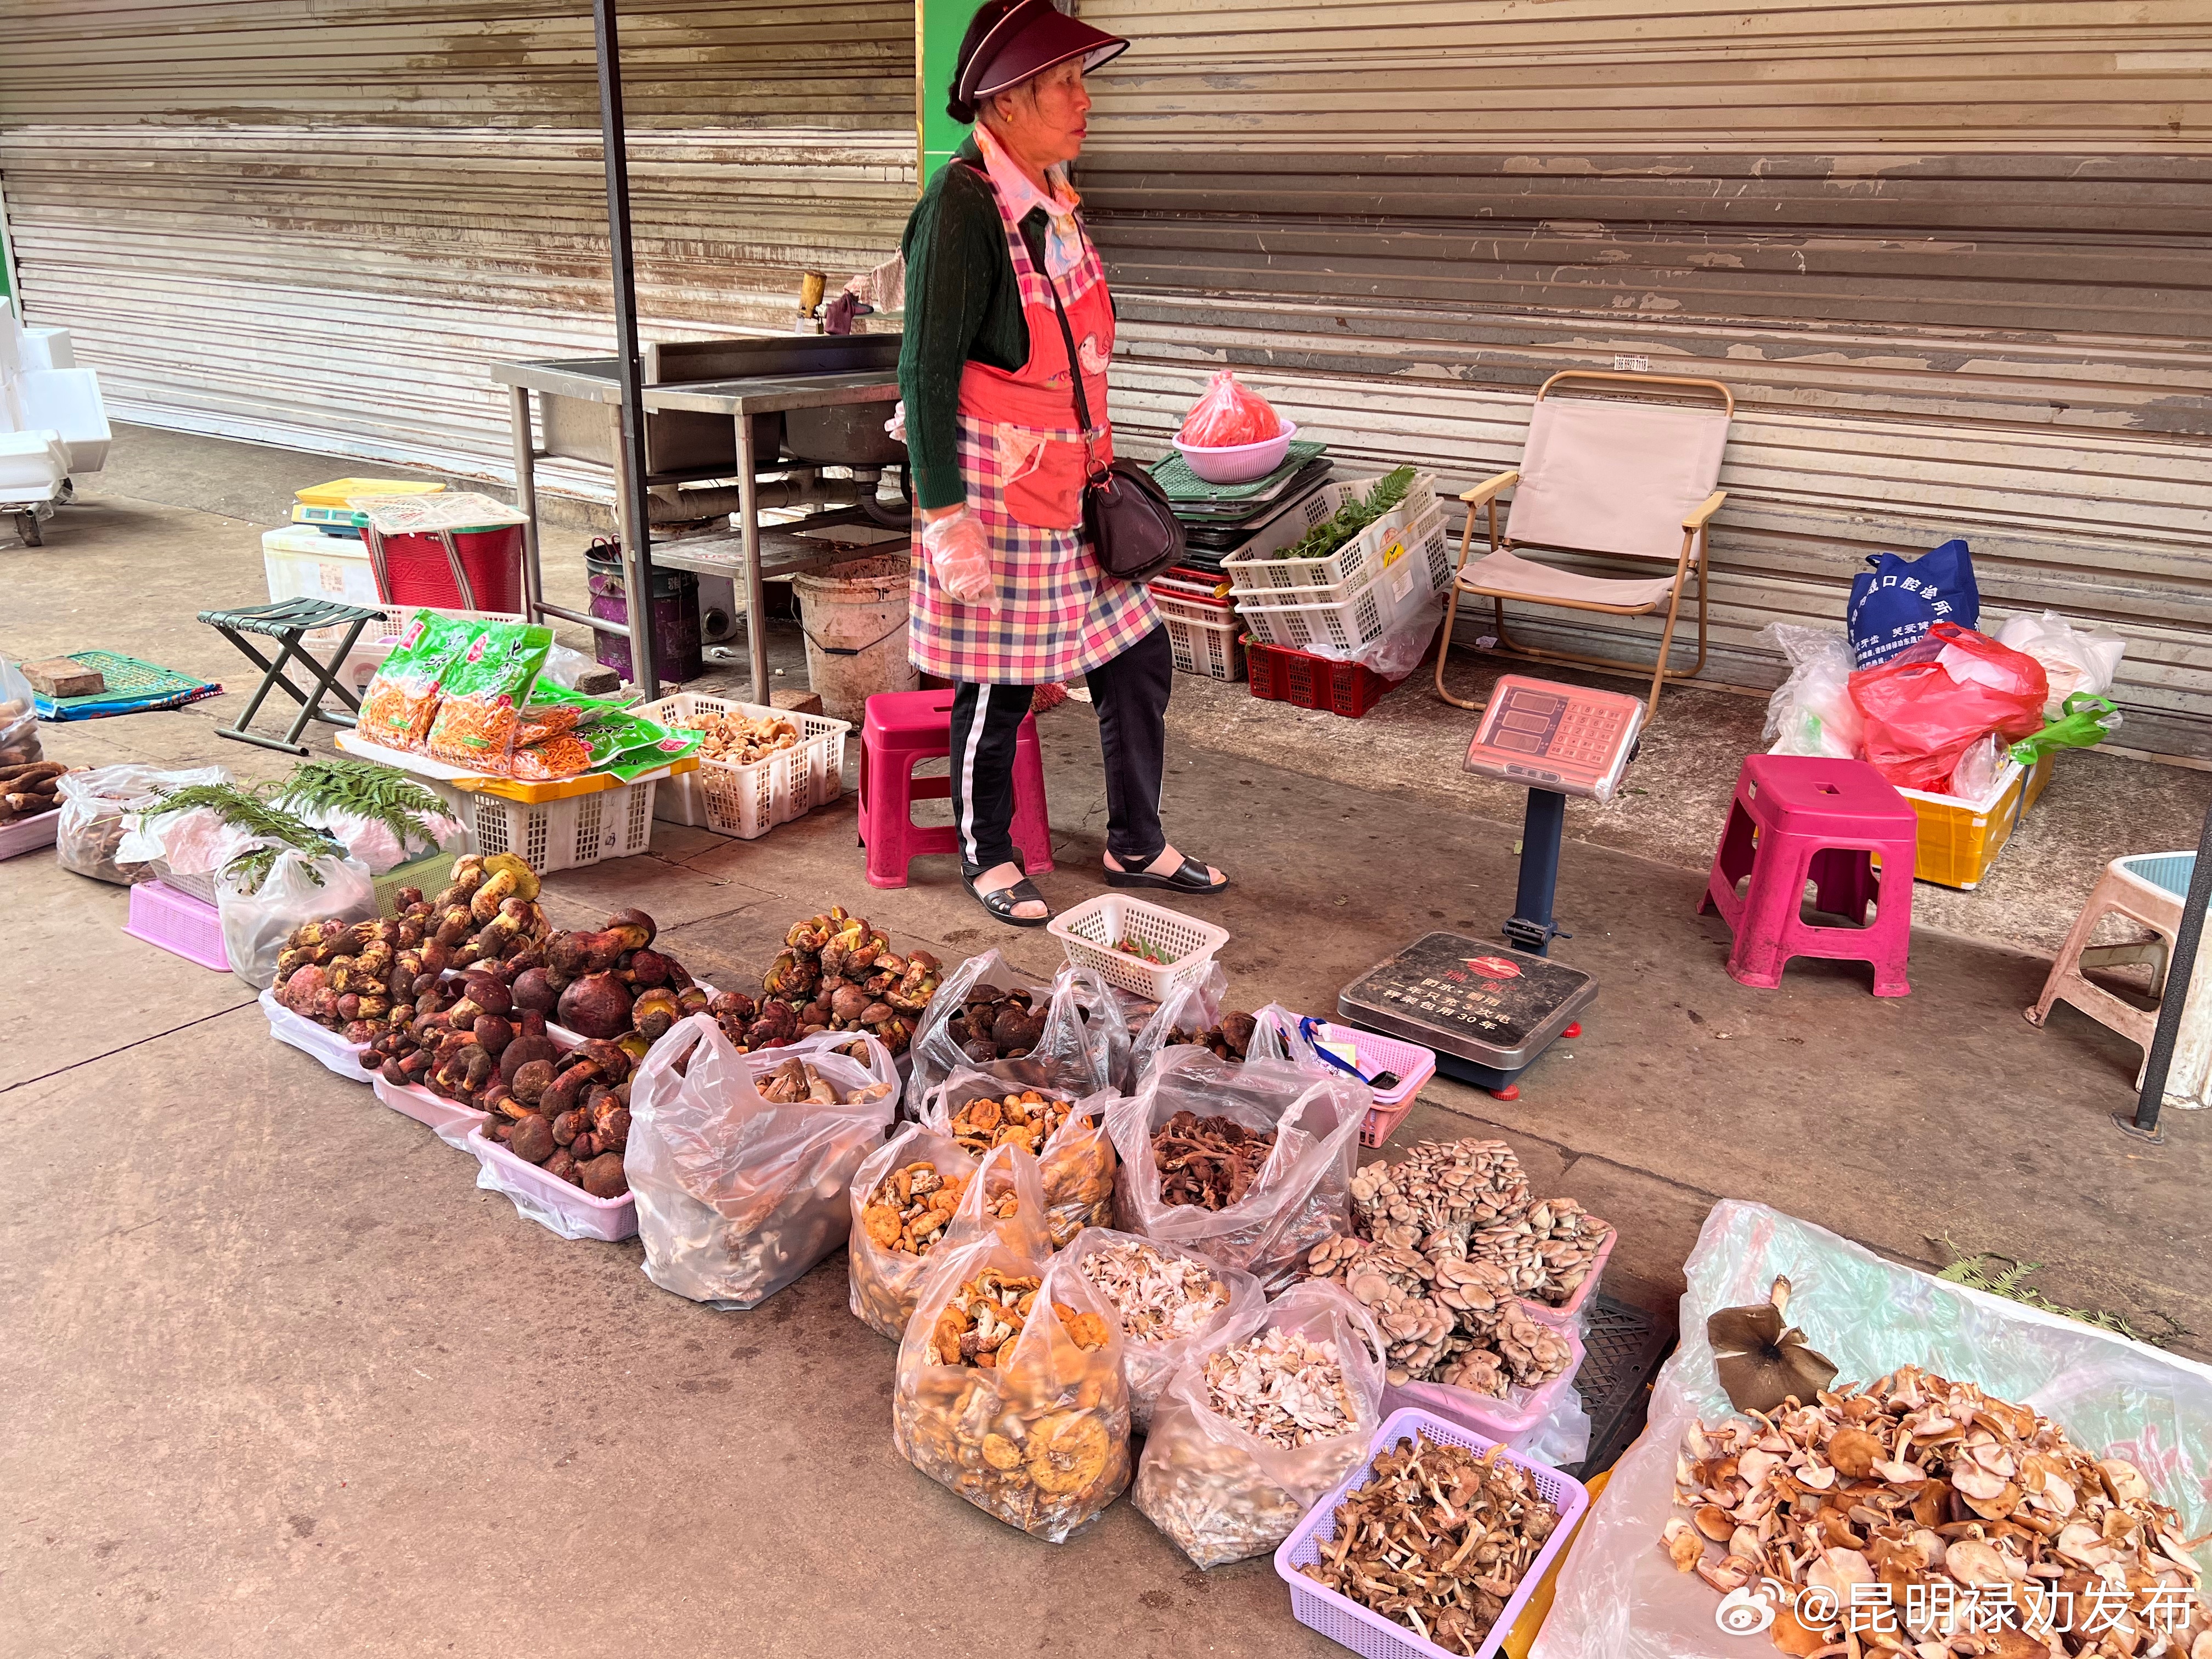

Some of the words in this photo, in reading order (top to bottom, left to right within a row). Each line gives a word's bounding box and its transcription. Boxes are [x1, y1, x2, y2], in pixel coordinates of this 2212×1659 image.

[1383, 989, 1498, 1030] 秤架包用30年
